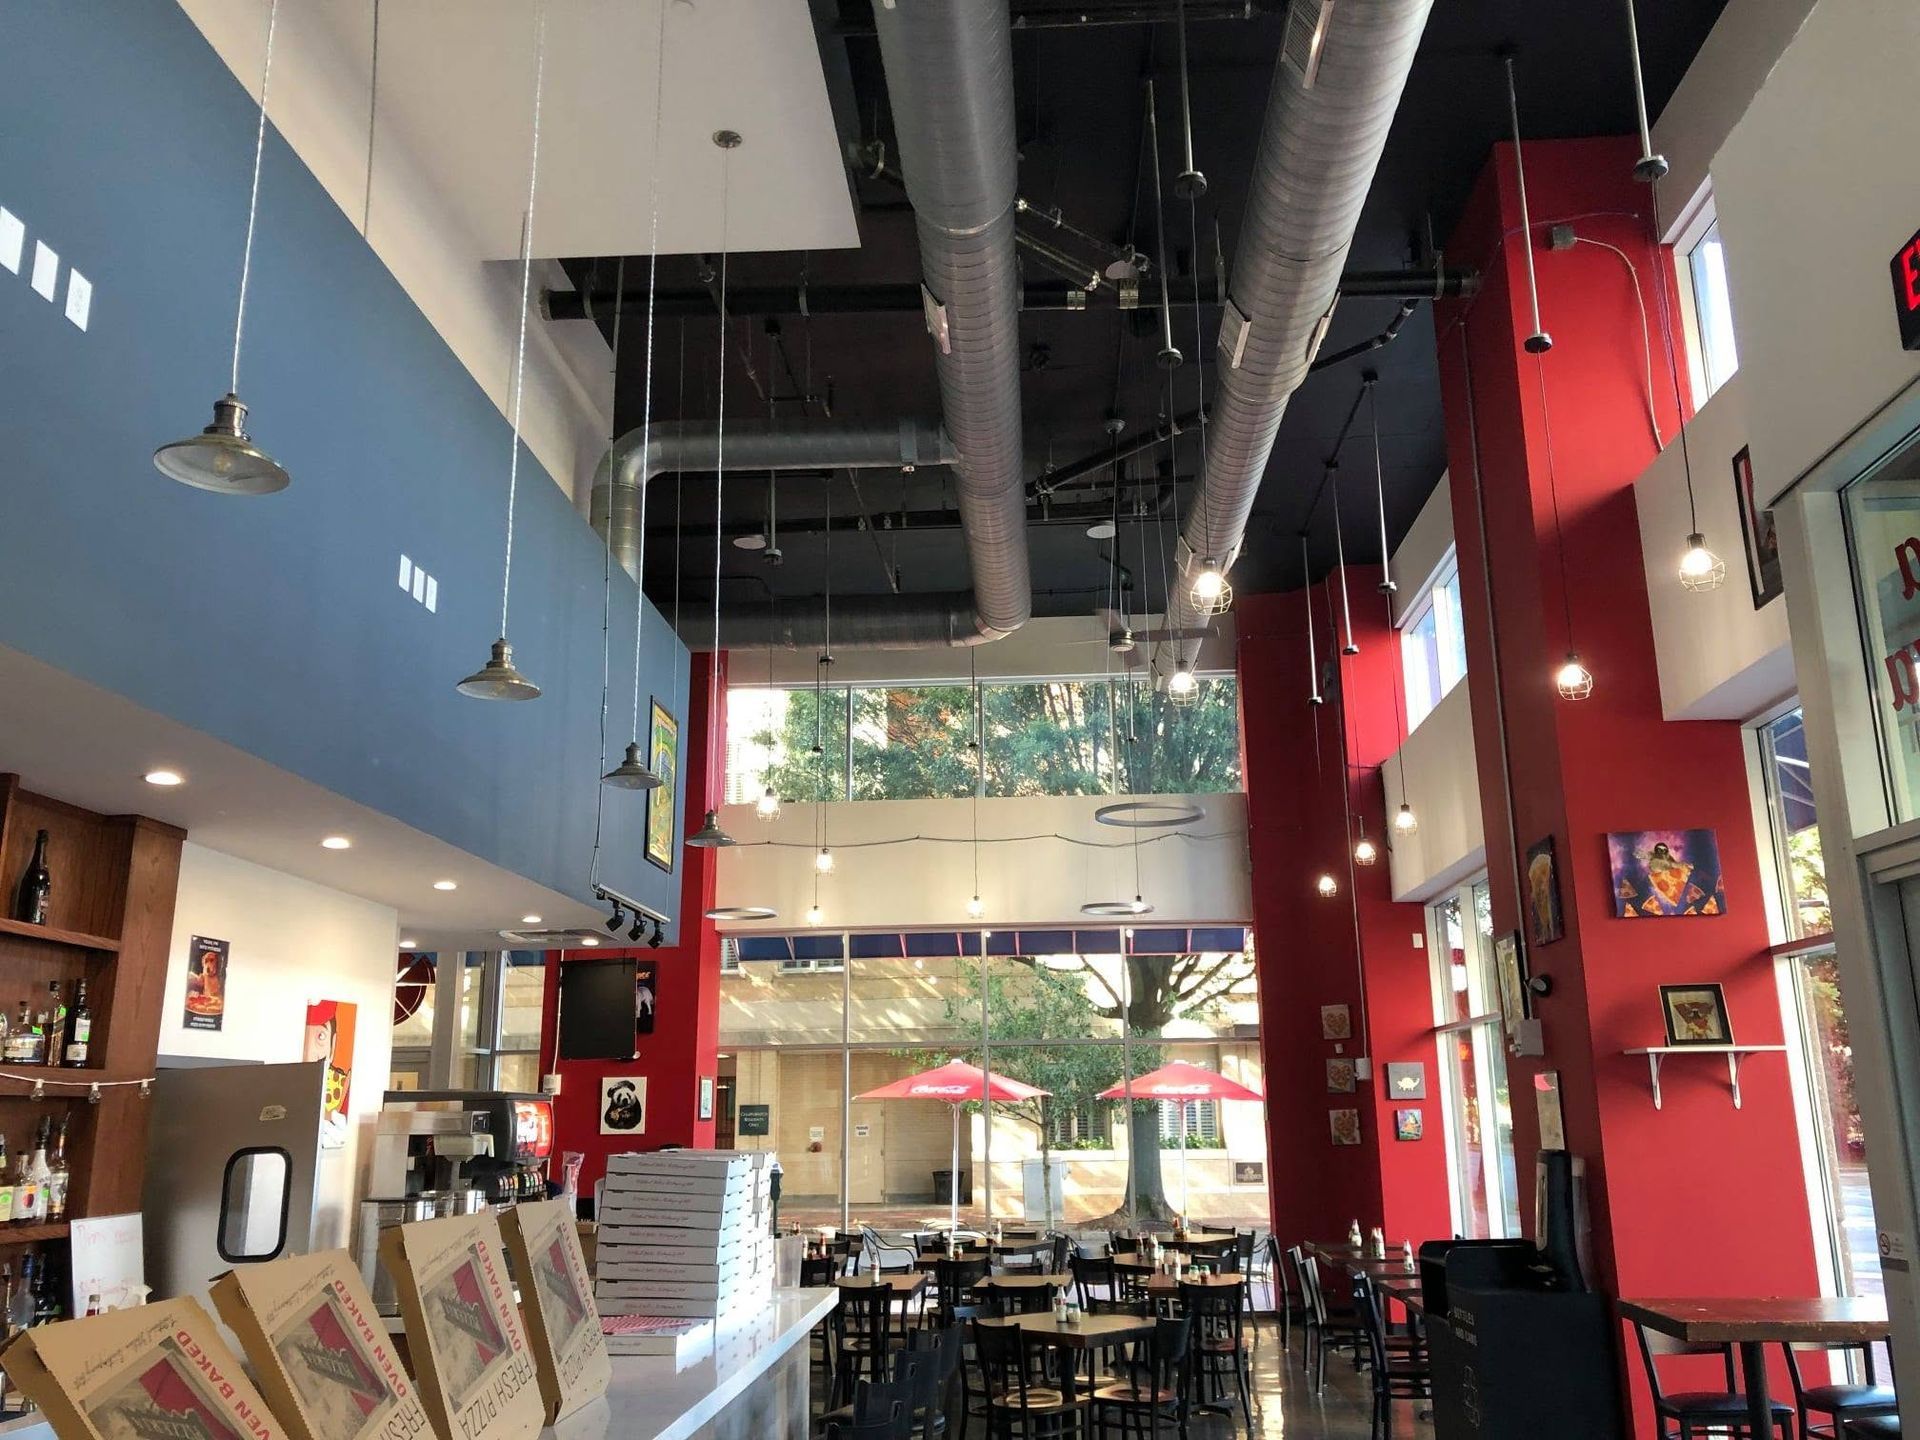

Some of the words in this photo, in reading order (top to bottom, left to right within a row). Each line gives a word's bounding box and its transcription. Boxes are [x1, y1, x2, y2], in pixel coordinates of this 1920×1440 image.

[477, 1240, 503, 1300] BAKED
[335, 1280, 375, 1343] BAKED
[500, 1303, 521, 1351] OVEN
[176, 1329, 235, 1400] BAKED
[373, 1344, 407, 1398] OVEN
[493, 1352, 532, 1407] FRESH
[235, 1400, 270, 1440] VEN
[458, 1389, 497, 1440] PIZZA
